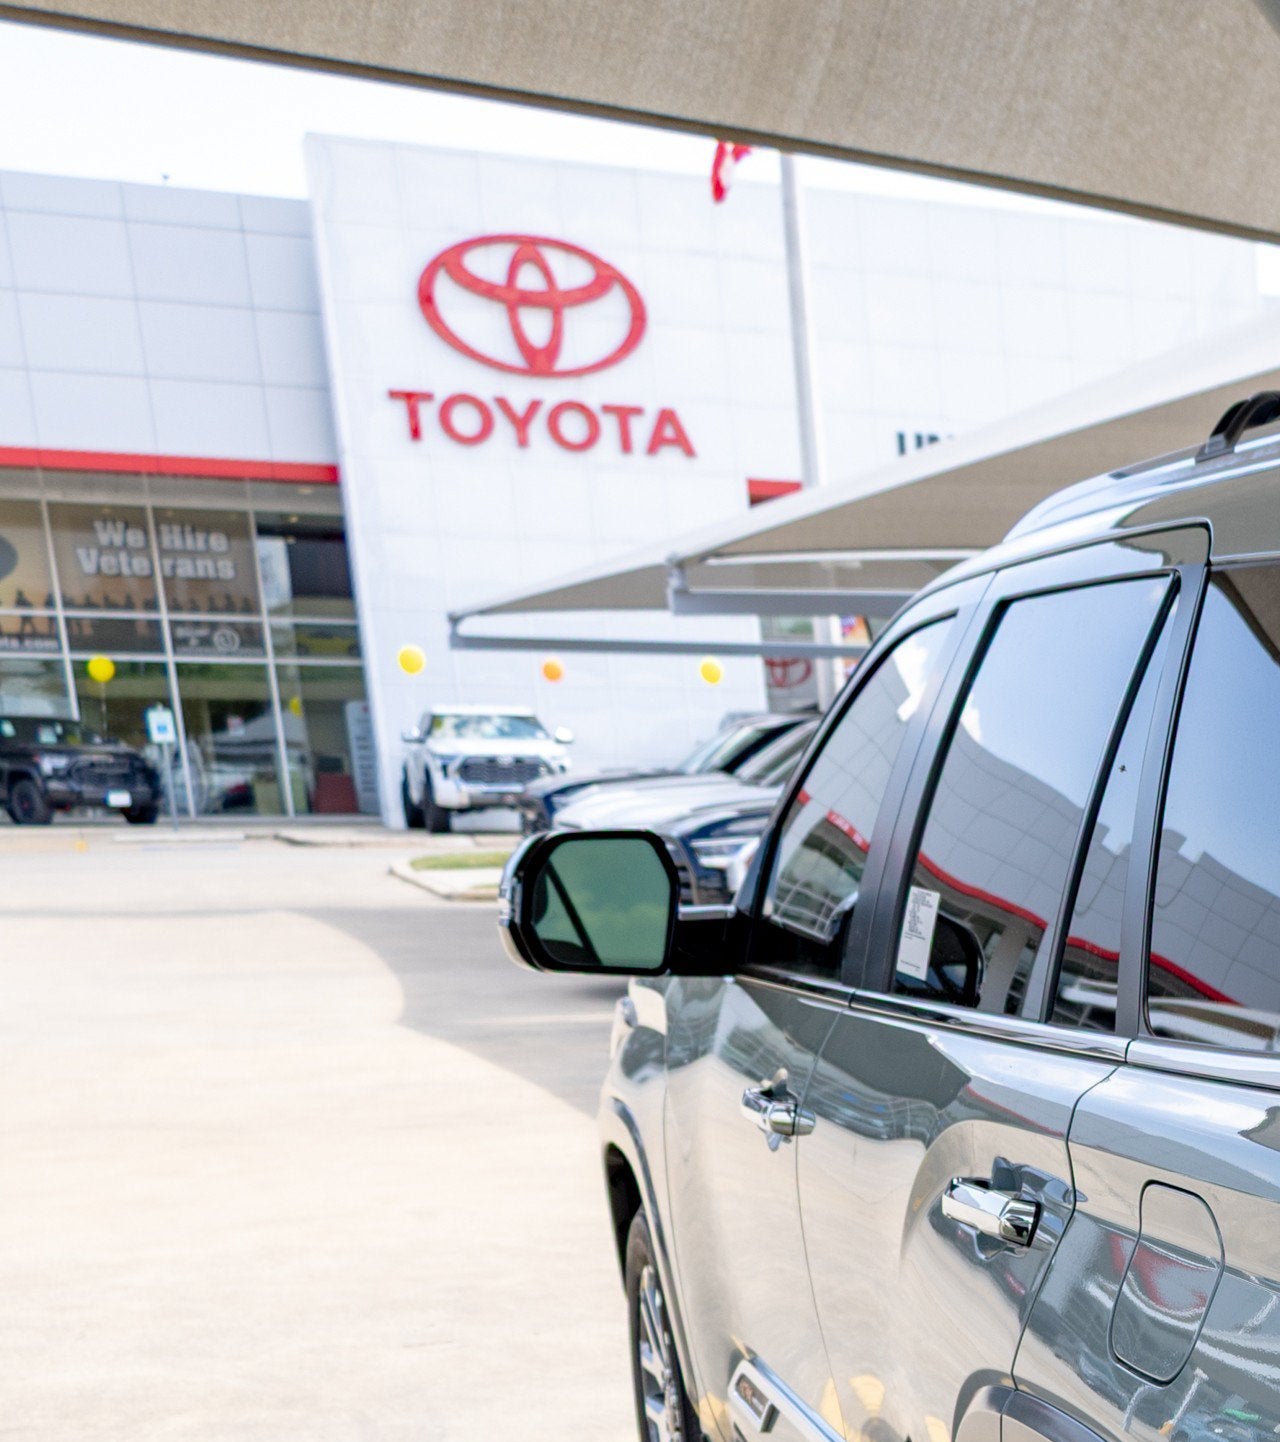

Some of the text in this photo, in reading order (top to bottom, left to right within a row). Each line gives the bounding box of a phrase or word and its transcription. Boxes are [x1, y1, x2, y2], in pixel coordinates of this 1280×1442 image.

[389, 390, 696, 458] TOYOTA
[94, 520, 229, 552] We Hire
[76, 548, 236, 580] Veterans
